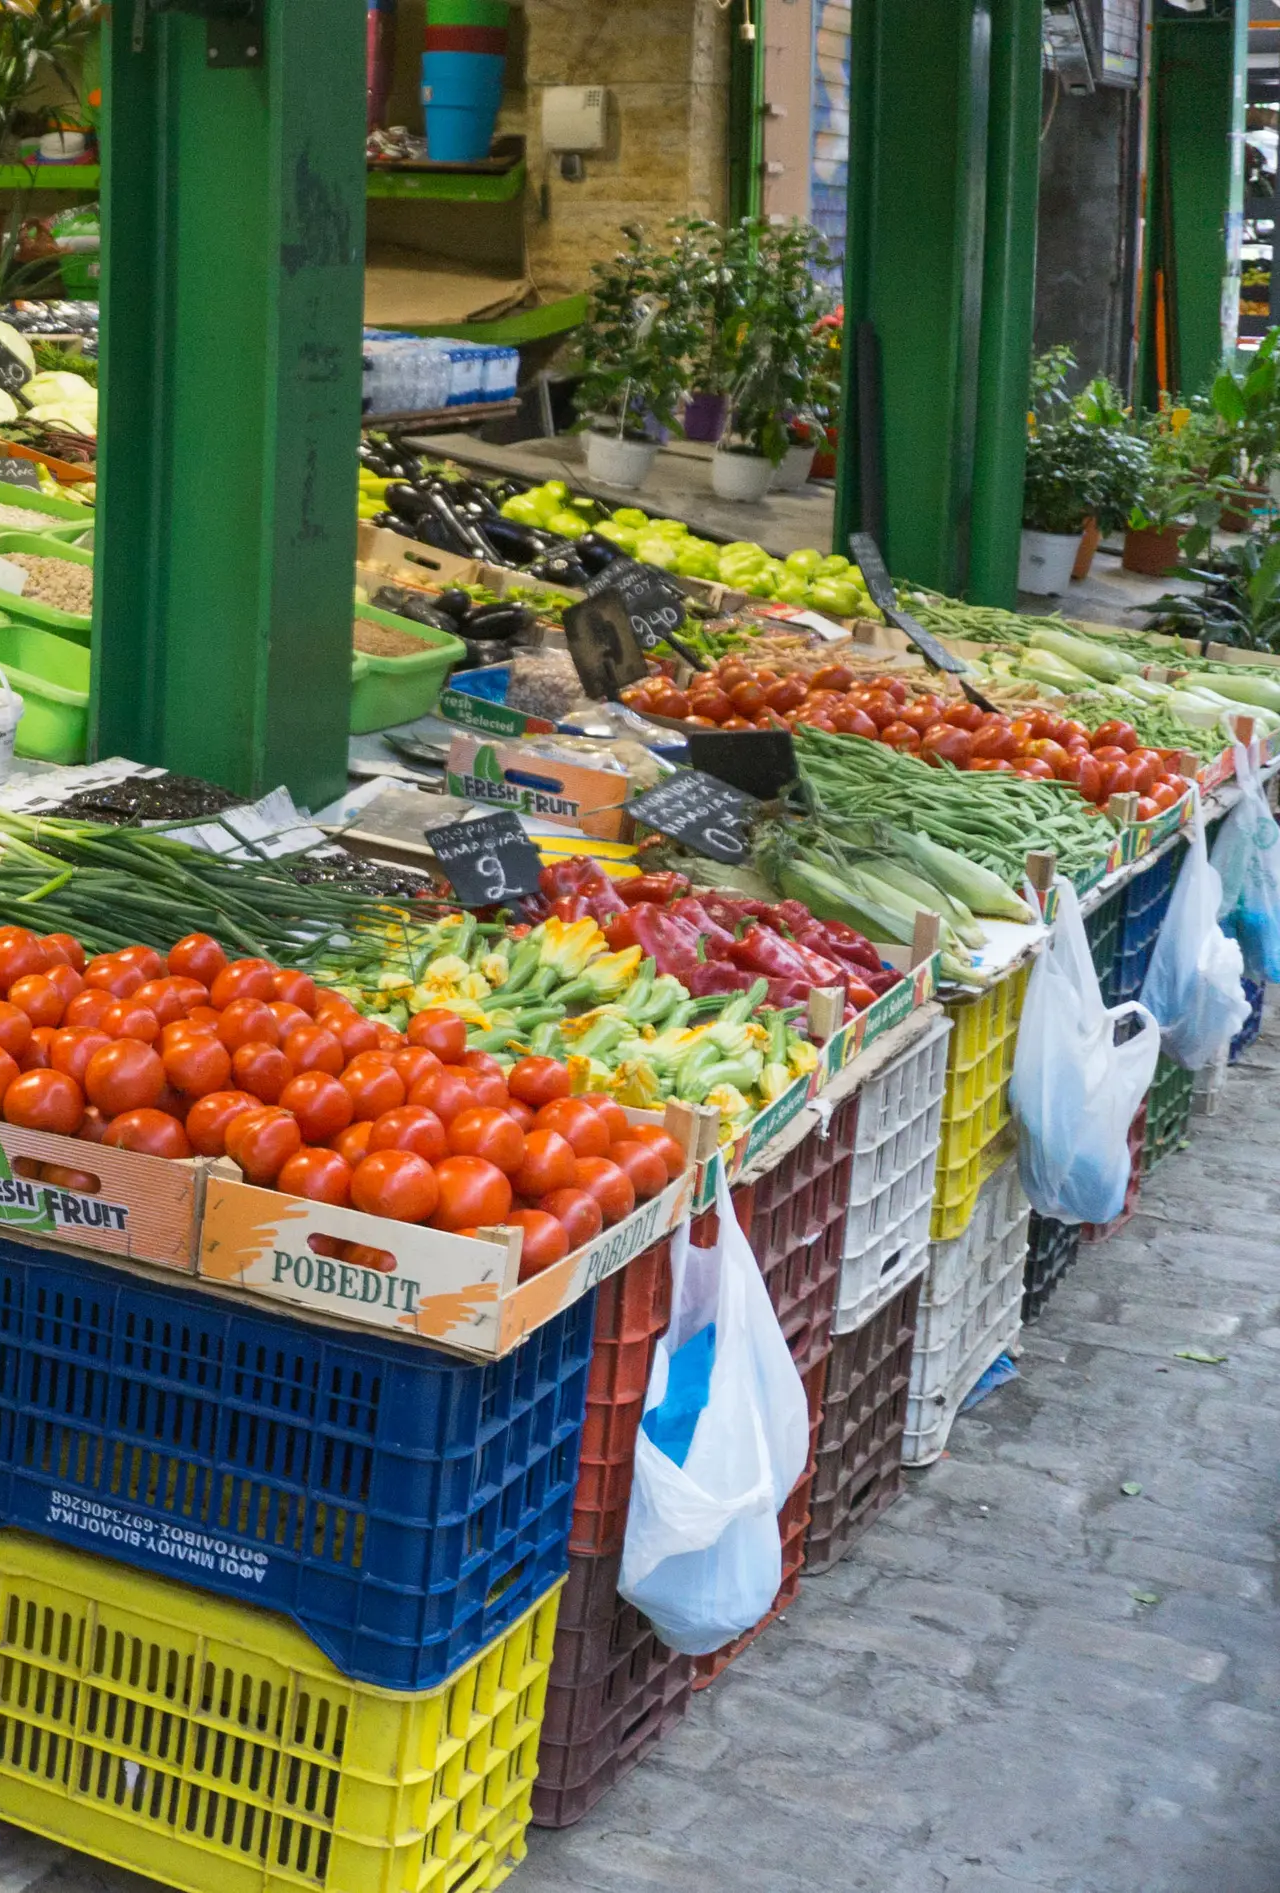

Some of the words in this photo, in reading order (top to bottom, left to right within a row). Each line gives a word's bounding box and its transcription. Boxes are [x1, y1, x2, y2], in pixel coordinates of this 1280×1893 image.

[464, 713, 516, 733] Selected
[463, 775, 519, 802] FRESH
[520, 789, 580, 818] FRUIT
[476, 855, 523, 899] 2
[46, 1192, 130, 1231] FRUIT
[582, 1200, 662, 1292] POBEDIT
[272, 1249, 422, 1313] POBEDIT
